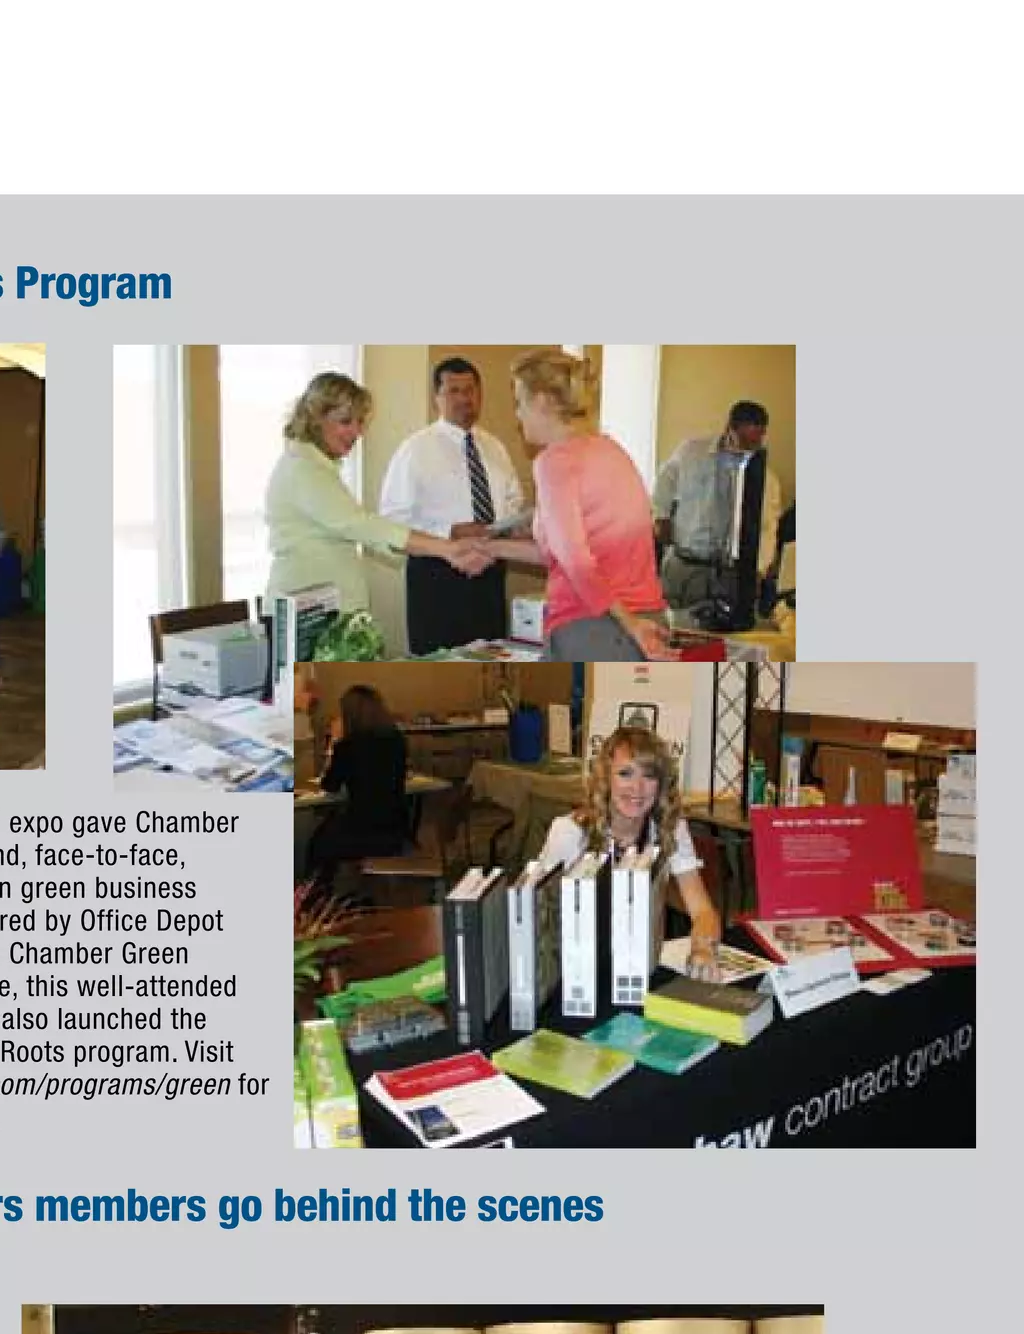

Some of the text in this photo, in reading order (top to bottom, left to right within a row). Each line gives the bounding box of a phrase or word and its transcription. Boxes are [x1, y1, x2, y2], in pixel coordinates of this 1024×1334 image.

[17, 266, 171, 307] Program
[10, 816, 63, 838] expo
[73, 816, 126, 838] gave
[136, 811, 239, 833] Chamber
[35, 844, 184, 869] face-to-face,
[46, 909, 71, 936] by
[81, 909, 146, 931] Office
[158, 909, 223, 936] Depot
[26, 975, 68, 997] this
[77, 975, 236, 997] well-attended
[238, 1073, 269, 1095] for
[784, 1055, 900, 1136] contract
[906, 1024, 973, 1088] group
[36, 1188, 206, 1222] members
[219, 1196, 262, 1229] go
[275, 1188, 396, 1222] behind
[408, 1188, 466, 1222] the
[478, 1196, 603, 1222] scenes
